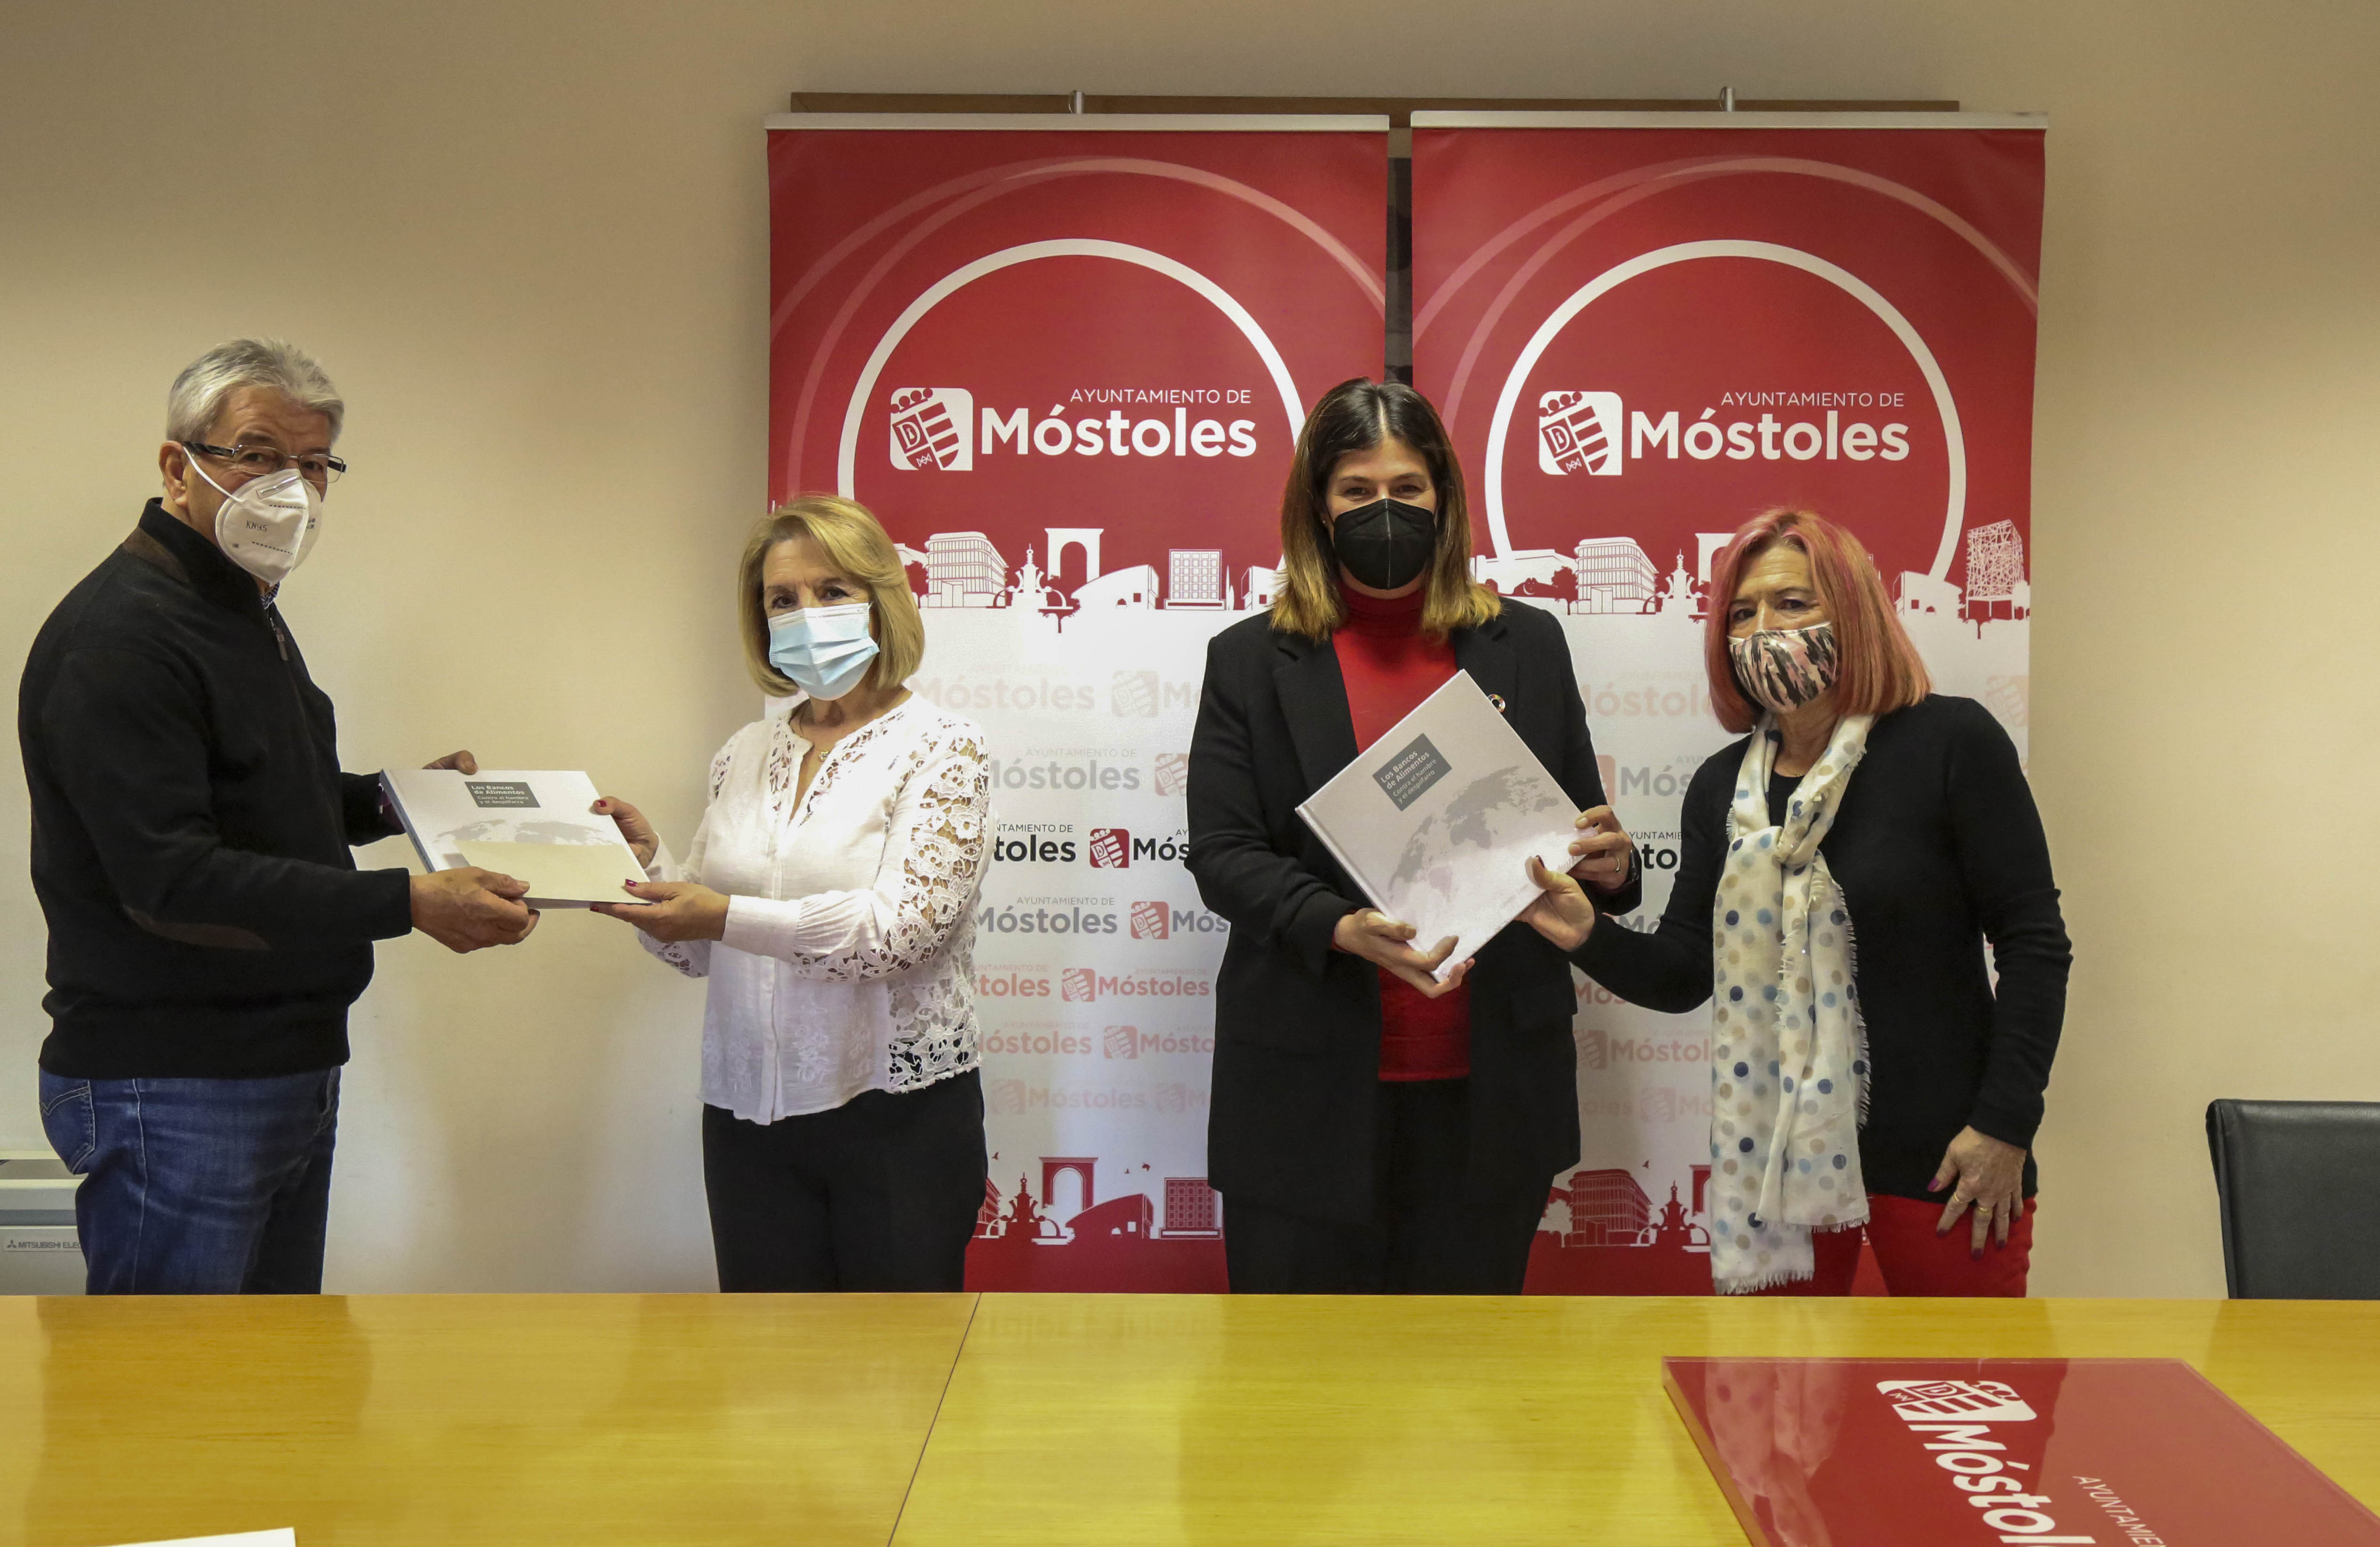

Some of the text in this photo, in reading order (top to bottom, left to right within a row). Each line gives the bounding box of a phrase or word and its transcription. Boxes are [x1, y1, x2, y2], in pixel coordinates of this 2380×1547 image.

[1070, 388, 1251, 404] AYUNTAMIENTO DE
[1721, 391, 1905, 407] AYUNTAMIENTO DE
[981, 403, 1258, 457] Móstoles
[1631, 407, 1910, 462] Móstoles
[246, 520, 267, 532] KN95
[1580, 682, 1713, 717] óstol
[1026, 748, 1137, 758] AYUNTAMIENTO DE
[1381, 750, 1418, 783] Los Bancos
[1386, 751, 1430, 789] de Alimentos
[1393, 780, 1411, 797] Contra
[1416, 758, 1436, 777] hambre
[1408, 770, 1435, 795] despilfarro
[997, 824, 1056, 832] NTAMIENTO
[1629, 831, 1683, 840] YUNTAMIE
[994, 834, 1076, 862] toles
[1017, 897, 1098, 905] AYUNTAMIENTO
[1098, 974, 1210, 996] Móstoles
[978, 1029, 1092, 1054] óstoles
[1140, 1032, 1215, 1053] Mósto
[1611, 1038, 1709, 1062] Móstol
[1908, 1425, 2096, 1547] Móstol
[2072, 1475, 2167, 1547] AYUNTAMIE
